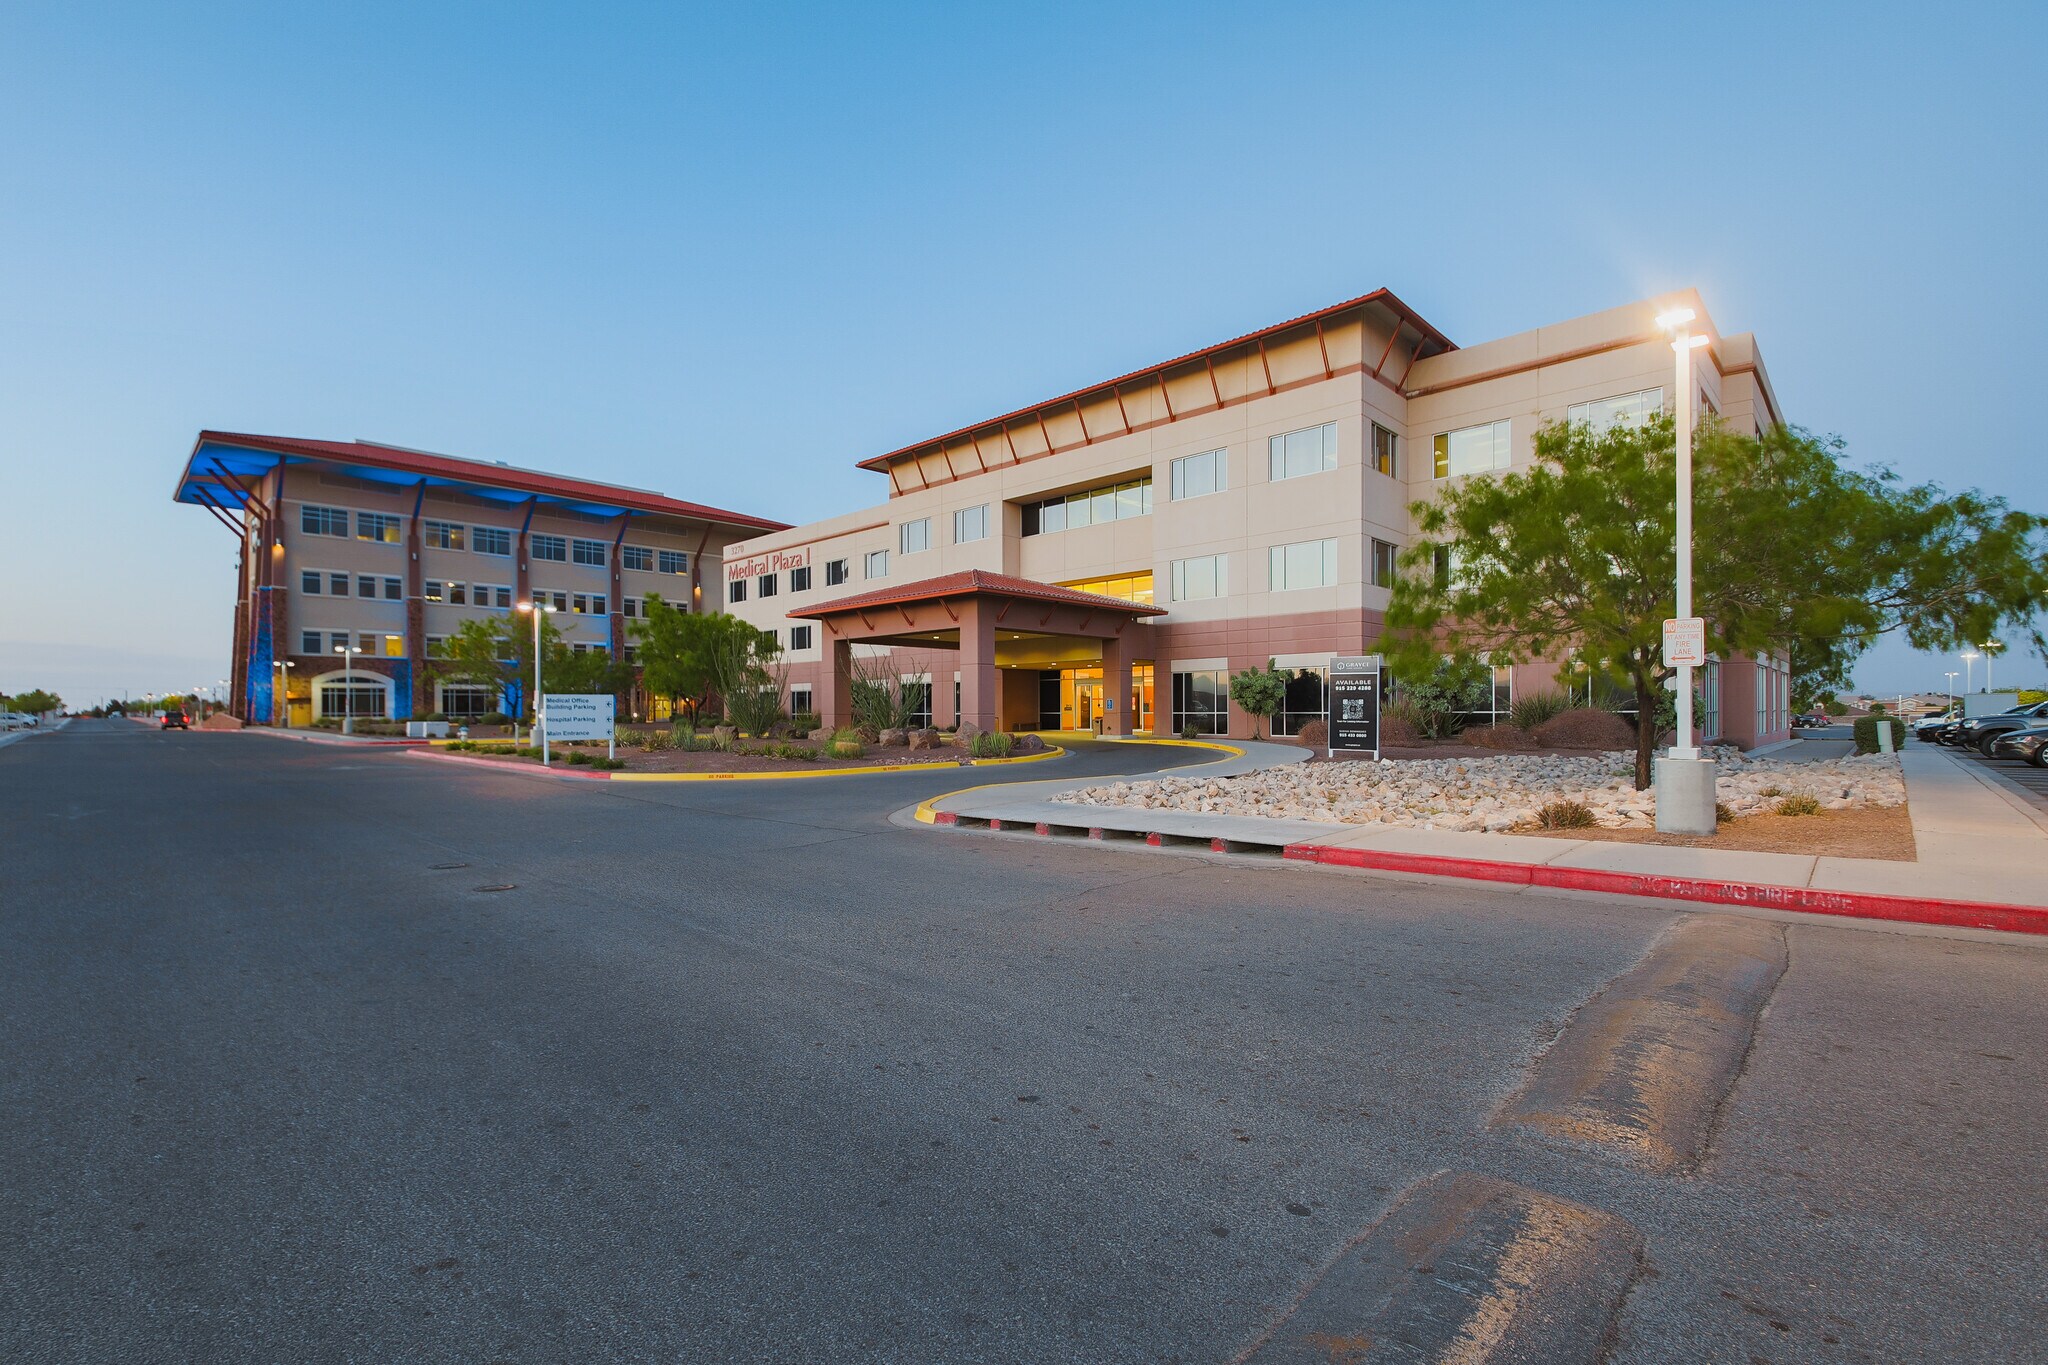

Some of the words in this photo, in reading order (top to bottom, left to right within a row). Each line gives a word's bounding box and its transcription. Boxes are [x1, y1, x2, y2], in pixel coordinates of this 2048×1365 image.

[731, 545, 745, 555] 3270
[728, 555, 769, 581] Medical
[772, 552, 803, 572] Plaza
[1665, 622, 1676, 632] NO
